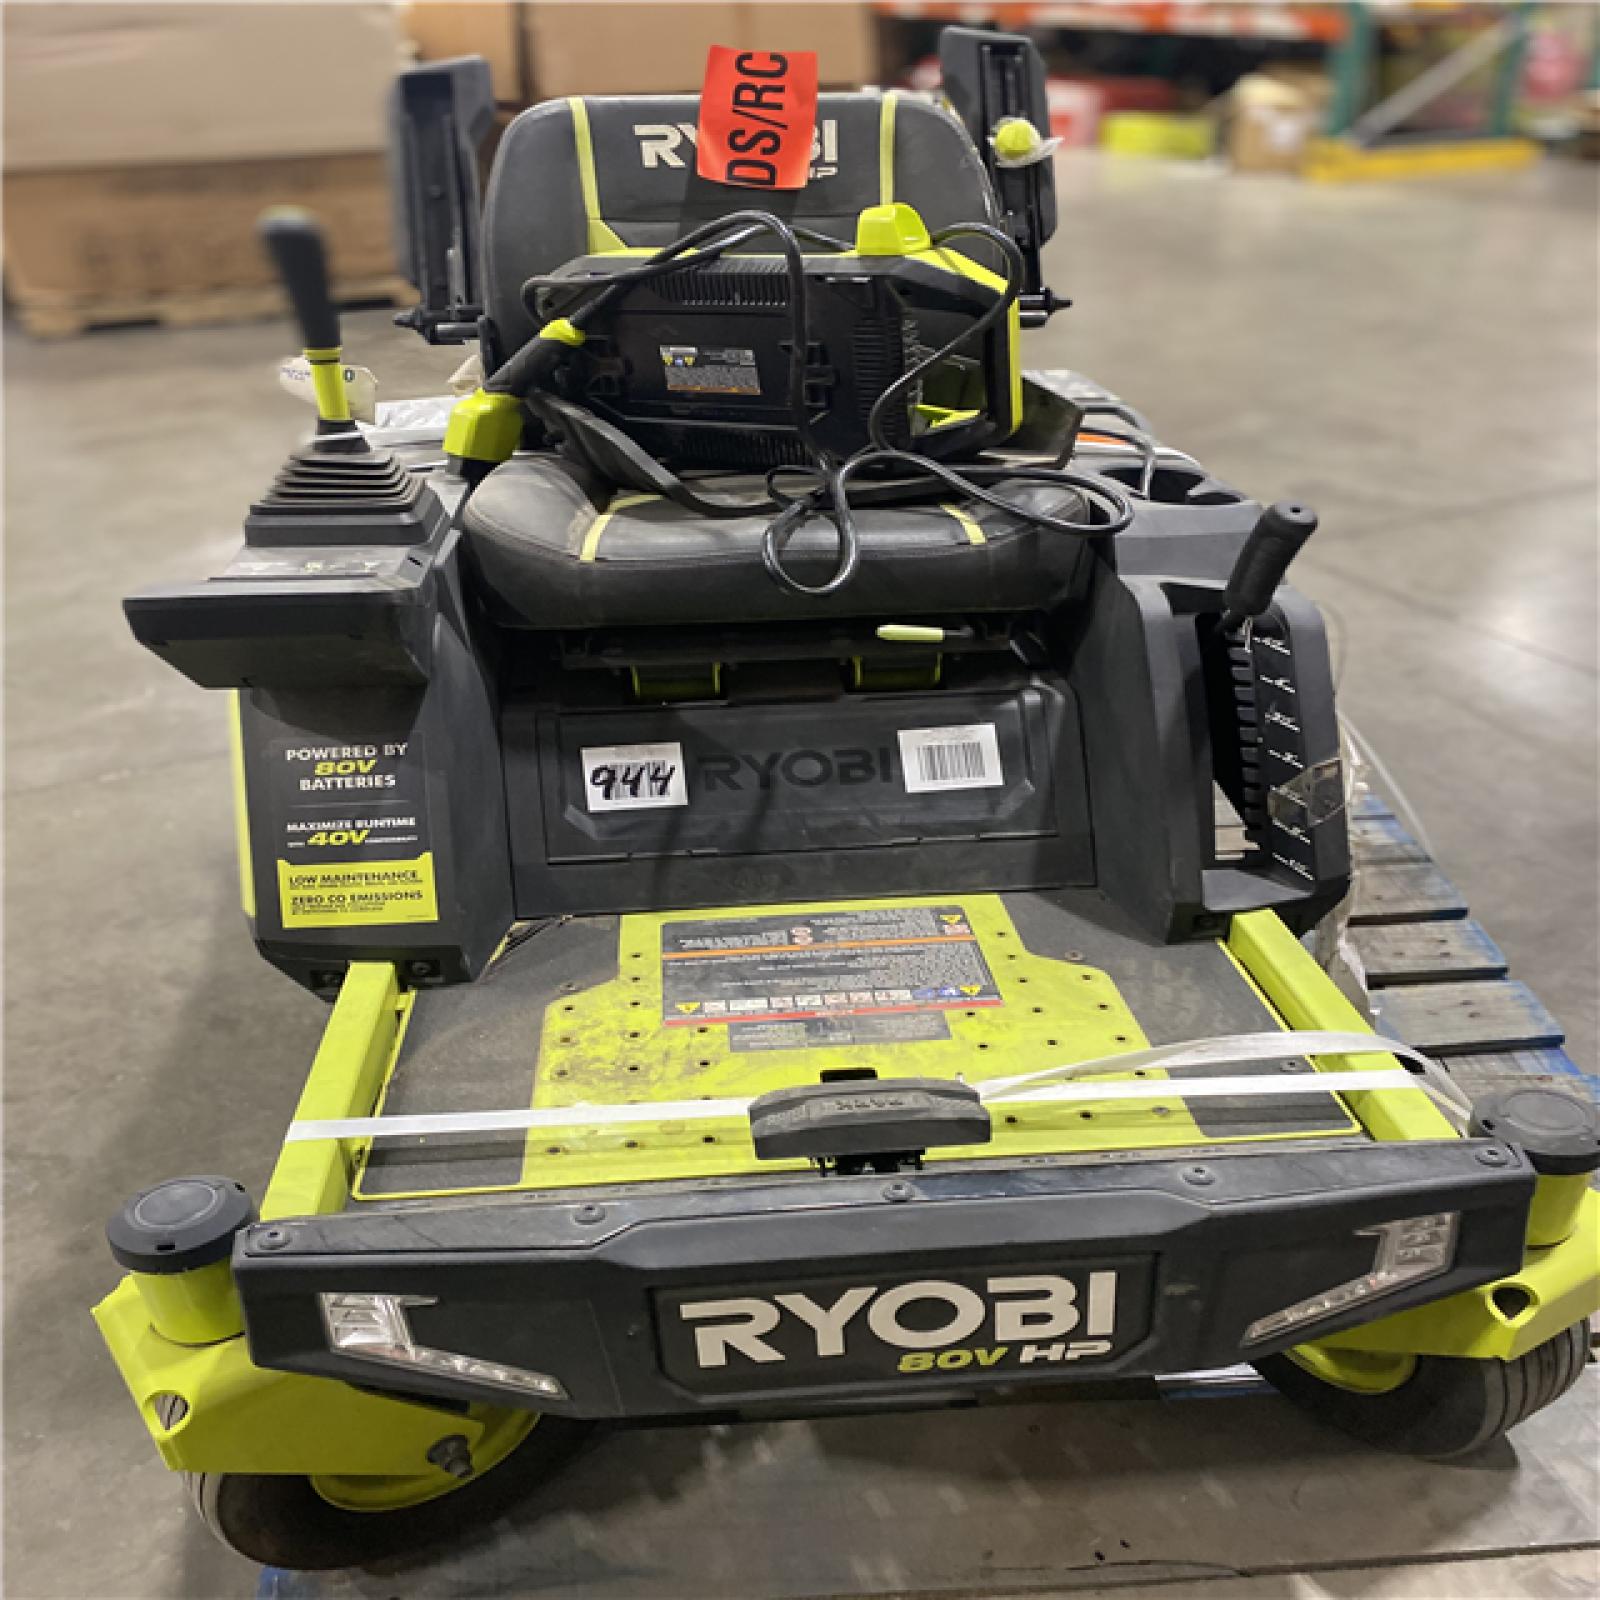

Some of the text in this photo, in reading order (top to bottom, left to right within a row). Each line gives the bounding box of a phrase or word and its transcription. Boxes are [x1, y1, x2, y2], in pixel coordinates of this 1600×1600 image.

[725, 52, 789, 186] DS/RC
[285, 743, 408, 760] POWERED BY
[315, 759, 377, 776] 80V
[699, 747, 893, 790] RYOBI
[300, 774, 396, 791] BATTERIES
[588, 763, 676, 801] 944
[307, 829, 370, 846] 40V
[290, 874, 317, 886] LOW
[320, 870, 416, 884] MAINTENANCE
[350, 889, 423, 903] EMISSIONS
[680, 1270, 1117, 1368] RYOBI
[896, 1340, 1114, 1373] 80V HP
